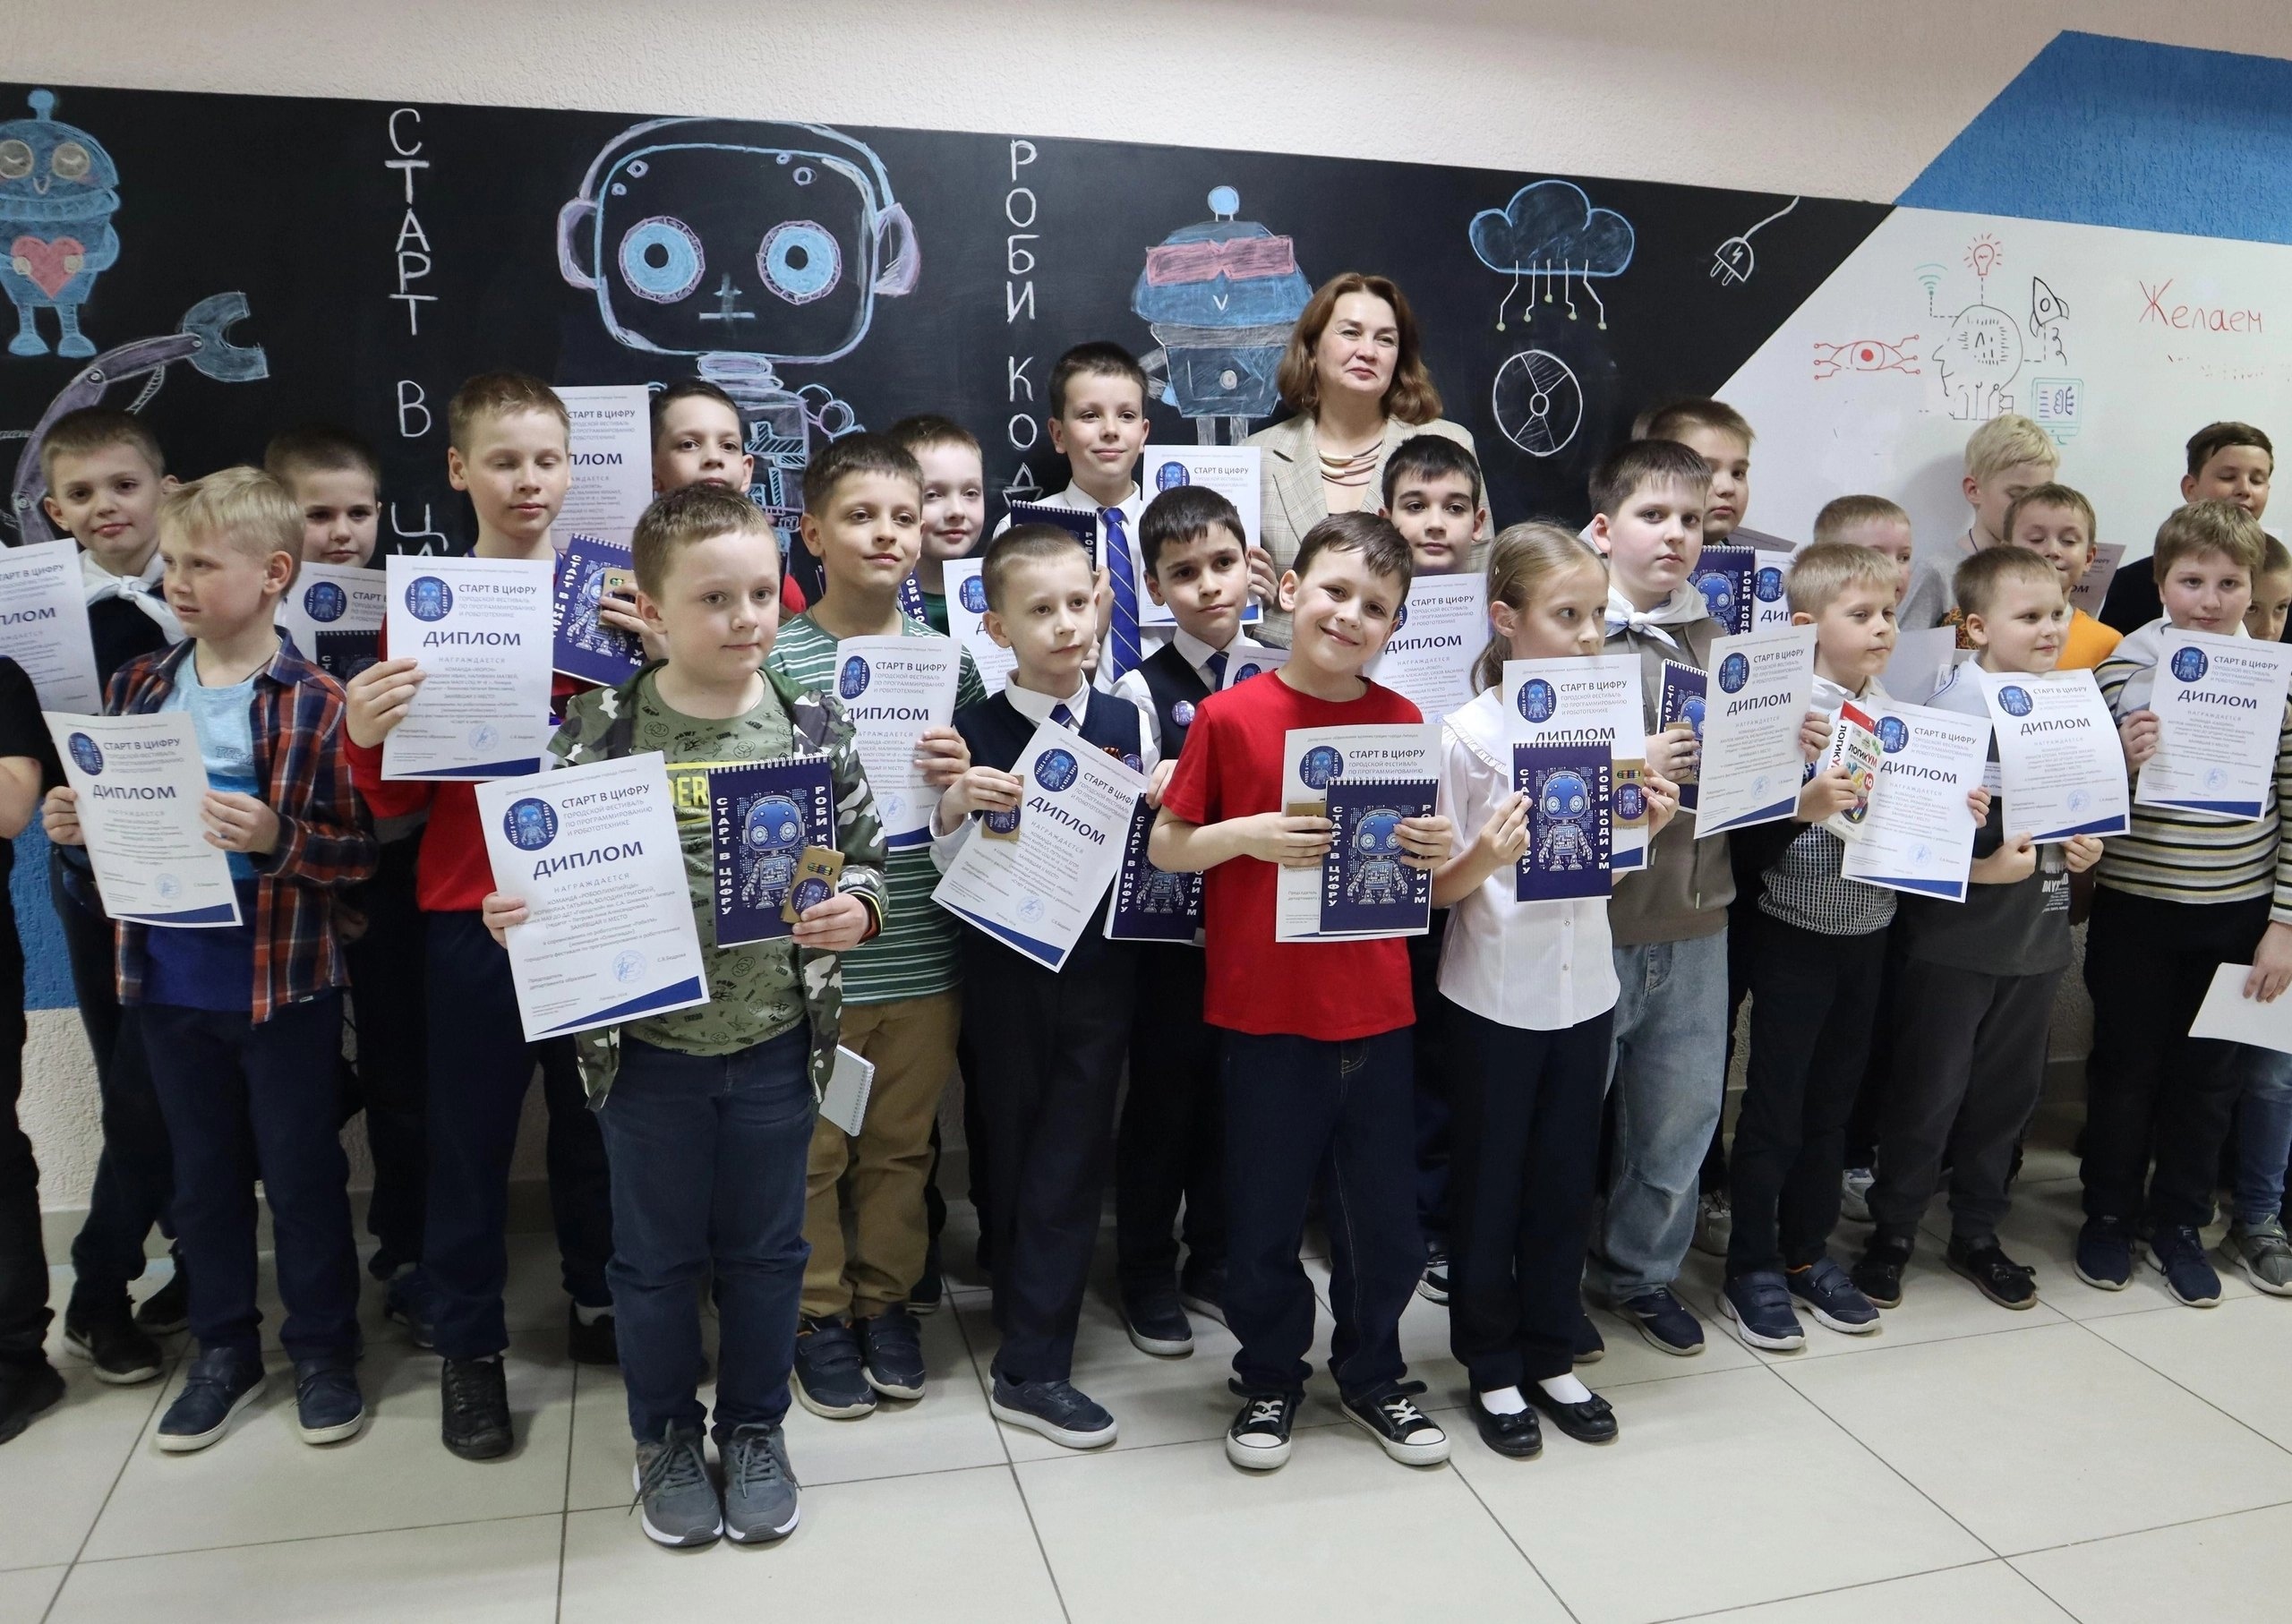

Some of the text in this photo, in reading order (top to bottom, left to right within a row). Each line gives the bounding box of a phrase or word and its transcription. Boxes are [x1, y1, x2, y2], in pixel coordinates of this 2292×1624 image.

[384, 107, 438, 437] СТАРТ В
[2139, 278, 2262, 333] Желаем
[1002, 139, 1043, 501] РОБИ КОД
[604, 410, 635, 418] ЦИФРУ
[570, 453, 622, 465] ПЛОМ
[1225, 467, 1249, 475] ЦИФРУ
[1084, 532, 1094, 553] РОБ
[0, 564, 64, 581] ТАРТ В ЦИФРУ
[563, 554, 582, 588] СТАРТ
[353, 591, 381, 602] СТАРТ
[458, 584, 490, 593] СТАРТ
[502, 585, 536, 595] ЦИФРУ
[906, 578, 920, 603] ОБИ
[1411, 597, 1435, 607] СТАРТ
[1445, 595, 1475, 606] ЦИФРУ
[1740, 570, 1751, 634] РОБИ КОДИ
[0, 607, 56, 625] ПЛОМ
[912, 607, 926, 622] КО
[423, 631, 520, 649] ДИПЛОМ
[1384, 635, 1461, 654] ДИПЛОМ
[1397, 656, 1450, 665] НАГРАЖДАЕТСЯ
[1753, 649, 1804, 663] СТАРТ В ЦИФРУ
[2213, 655, 2279, 671] СТАРТ В ЦИФРУ
[876, 662, 904, 670] СТАРТ
[916, 662, 946, 672] ЦИФРУ
[1561, 680, 1627, 692] СТАРТ В ЦИФРУ
[1570, 699, 1627, 707] ПРОГРАММИРОВАНИЮ
[1665, 685, 1674, 722] СТАРТ
[1726, 692, 1792, 716] ДИПЛОМ
[2177, 688, 2257, 711] ДИПЛОМ
[1735, 716, 1780, 728] НАГРАЖДАЕТСЯ
[2187, 709, 2241, 722] НАГРАЖДАЕТСЯ
[1535, 727, 1616, 742] ДИПЛОМ
[1914, 727, 1938, 737] СТАРТ
[1948, 733, 1976, 745] ЦИФРУ
[2020, 717, 2091, 736] ДИПЛОМ
[103, 739, 180, 750] СТАРТ В ЦИФРУ
[1349, 750, 1379, 758] СТАРТ
[1390, 749, 1424, 759] ЦИФРУ
[1832, 725, 1847, 767] ЛОГИКУ
[1848, 743, 1877, 768] ЛОГИКУМ
[1519, 768, 1530, 795] СТА
[1865, 776, 1873, 787] IQ
[1880, 760, 1957, 784] ДИПЛОМ
[92, 784, 177, 800] ДИПЛОМ
[560, 782, 650, 809] СТАРТ В ЦИФРУ
[1078, 782, 1130, 814] ГОРОДСКОЙ ФЕСТИВАЛЬ
[1083, 772, 1134, 806] СТАРТ В ЦИФ
[1889, 782, 1942, 796] НАГРАЖДАЕТСЯ
[563, 797, 644, 820] ГОРОДСКОЙ ФЕСТИВАЛЬ
[577, 804, 652, 827] ПРОГРАММИРОВАНИЮ
[815, 786, 828, 826] РОБИ
[1073, 797, 1112, 820] РОБОТОТЕХНИКЕ
[574, 817, 630, 836] РОБОТОТЕХНИКЕ
[1026, 793, 1107, 845] ДИПЛОМ
[1331, 806, 1343, 846] СТАРТ
[1598, 766, 1609, 869] РОБИ КОДИ УМ
[1030, 821, 1084, 854] НАГРАЖДАЕТСЯ
[1131, 816, 1145, 854] СТАРТ
[530, 839, 644, 879] ДИПЛОМ
[716, 797, 733, 915] СТАРТ В ЦИФРУ
[553, 871, 630, 894] НАГРАЖДАЕТСЯ
[1120, 873, 1134, 912] ЦИФРУ
[1327, 866, 1340, 907] ЦИФРУ
[1414, 887, 1427, 903] УМ
[1186, 900, 1198, 916] УМ
